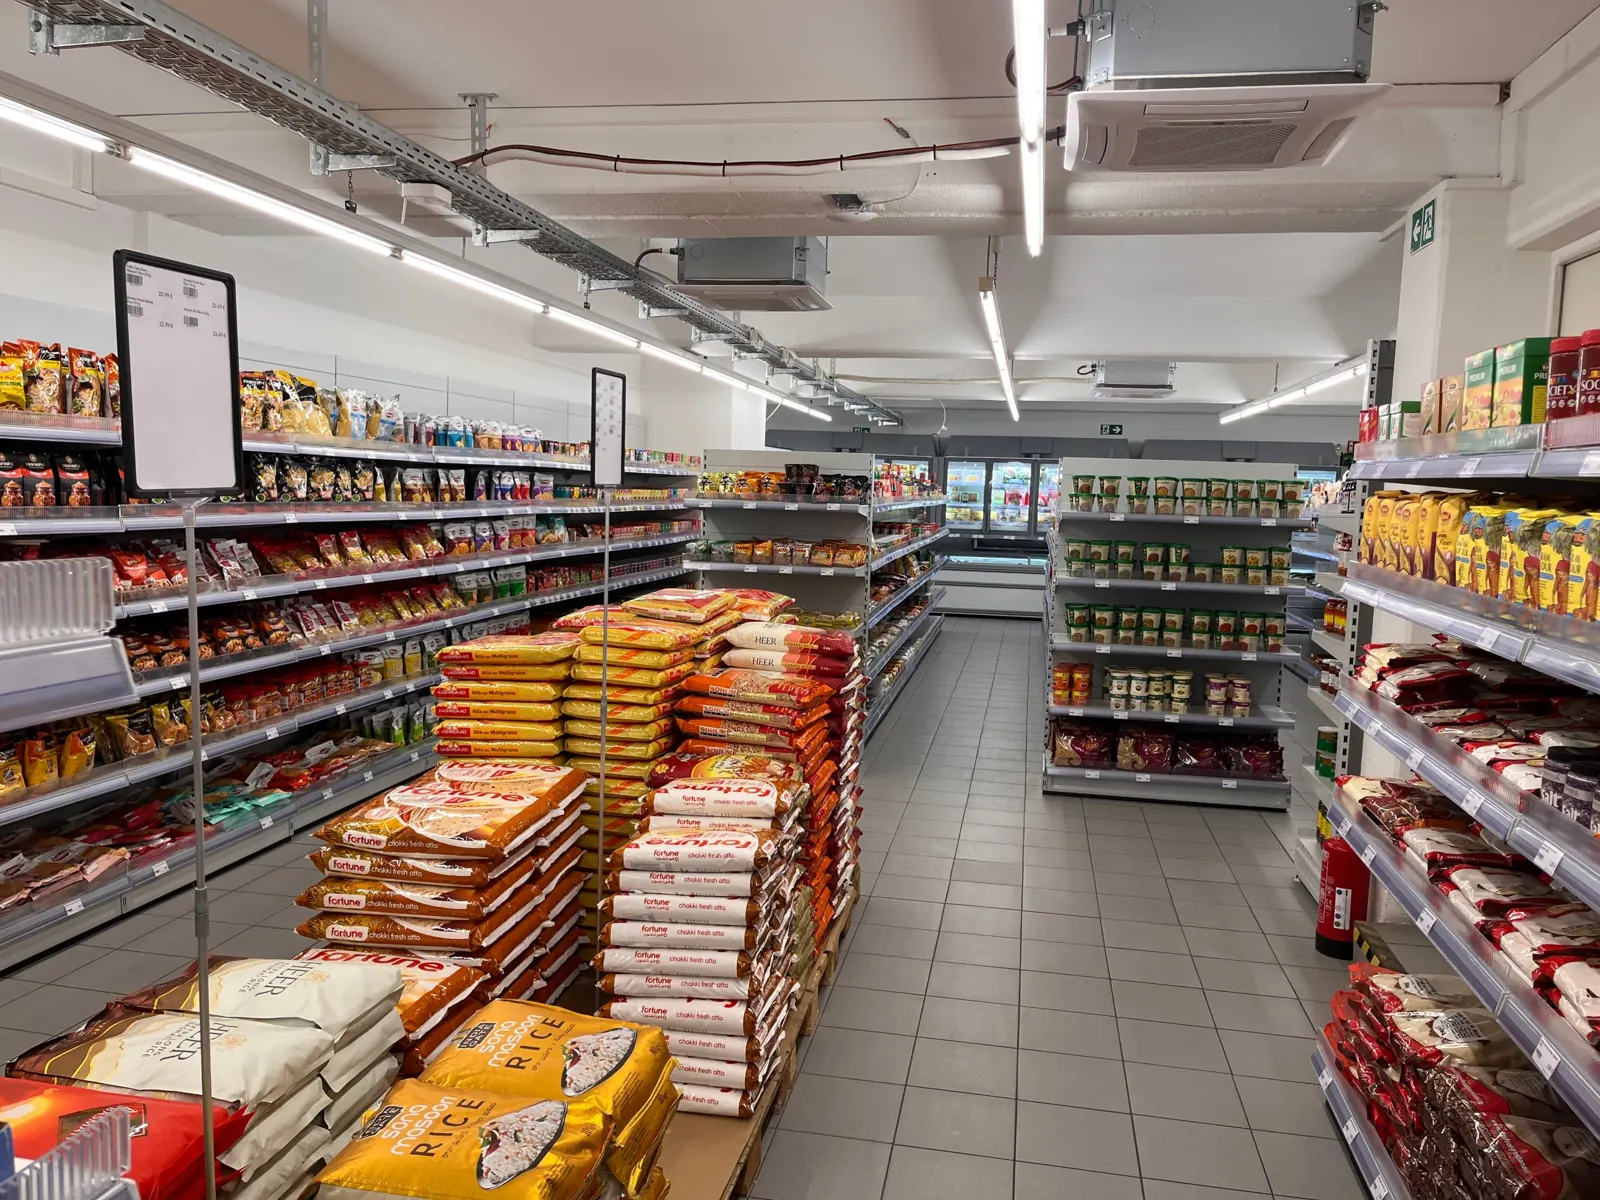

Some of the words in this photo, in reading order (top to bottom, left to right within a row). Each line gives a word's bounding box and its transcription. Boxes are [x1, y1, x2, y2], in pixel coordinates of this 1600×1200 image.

[754, 636, 777, 645] HEER
[752, 657, 774, 667] HEER
[447, 762, 562, 772] fortune
[399, 787, 524, 801] fortune
[674, 783, 770, 797] fortune
[348, 834, 381, 846] fortune
[646, 839, 752, 849] fortune
[334, 860, 365, 871] fortune
[393, 868, 408, 876] fresh
[328, 895, 360, 906] fortune
[331, 927, 363, 938] fortune
[310, 949, 444, 973] fortune
[255, 961, 323, 996] HEER
[645, 976, 672, 984] fortune
[641, 1006, 667, 1014] fortune
[460, 1024, 486, 1047] INDIA
[469, 1024, 493, 1047] GATE
[480, 1021, 516, 1052] sona
[142, 1041, 162, 1058] RICE
[153, 1039, 176, 1056] LONG
[505, 1017, 565, 1070] RICE
[381, 1104, 428, 1139] sona
[410, 1098, 484, 1158] RICE
